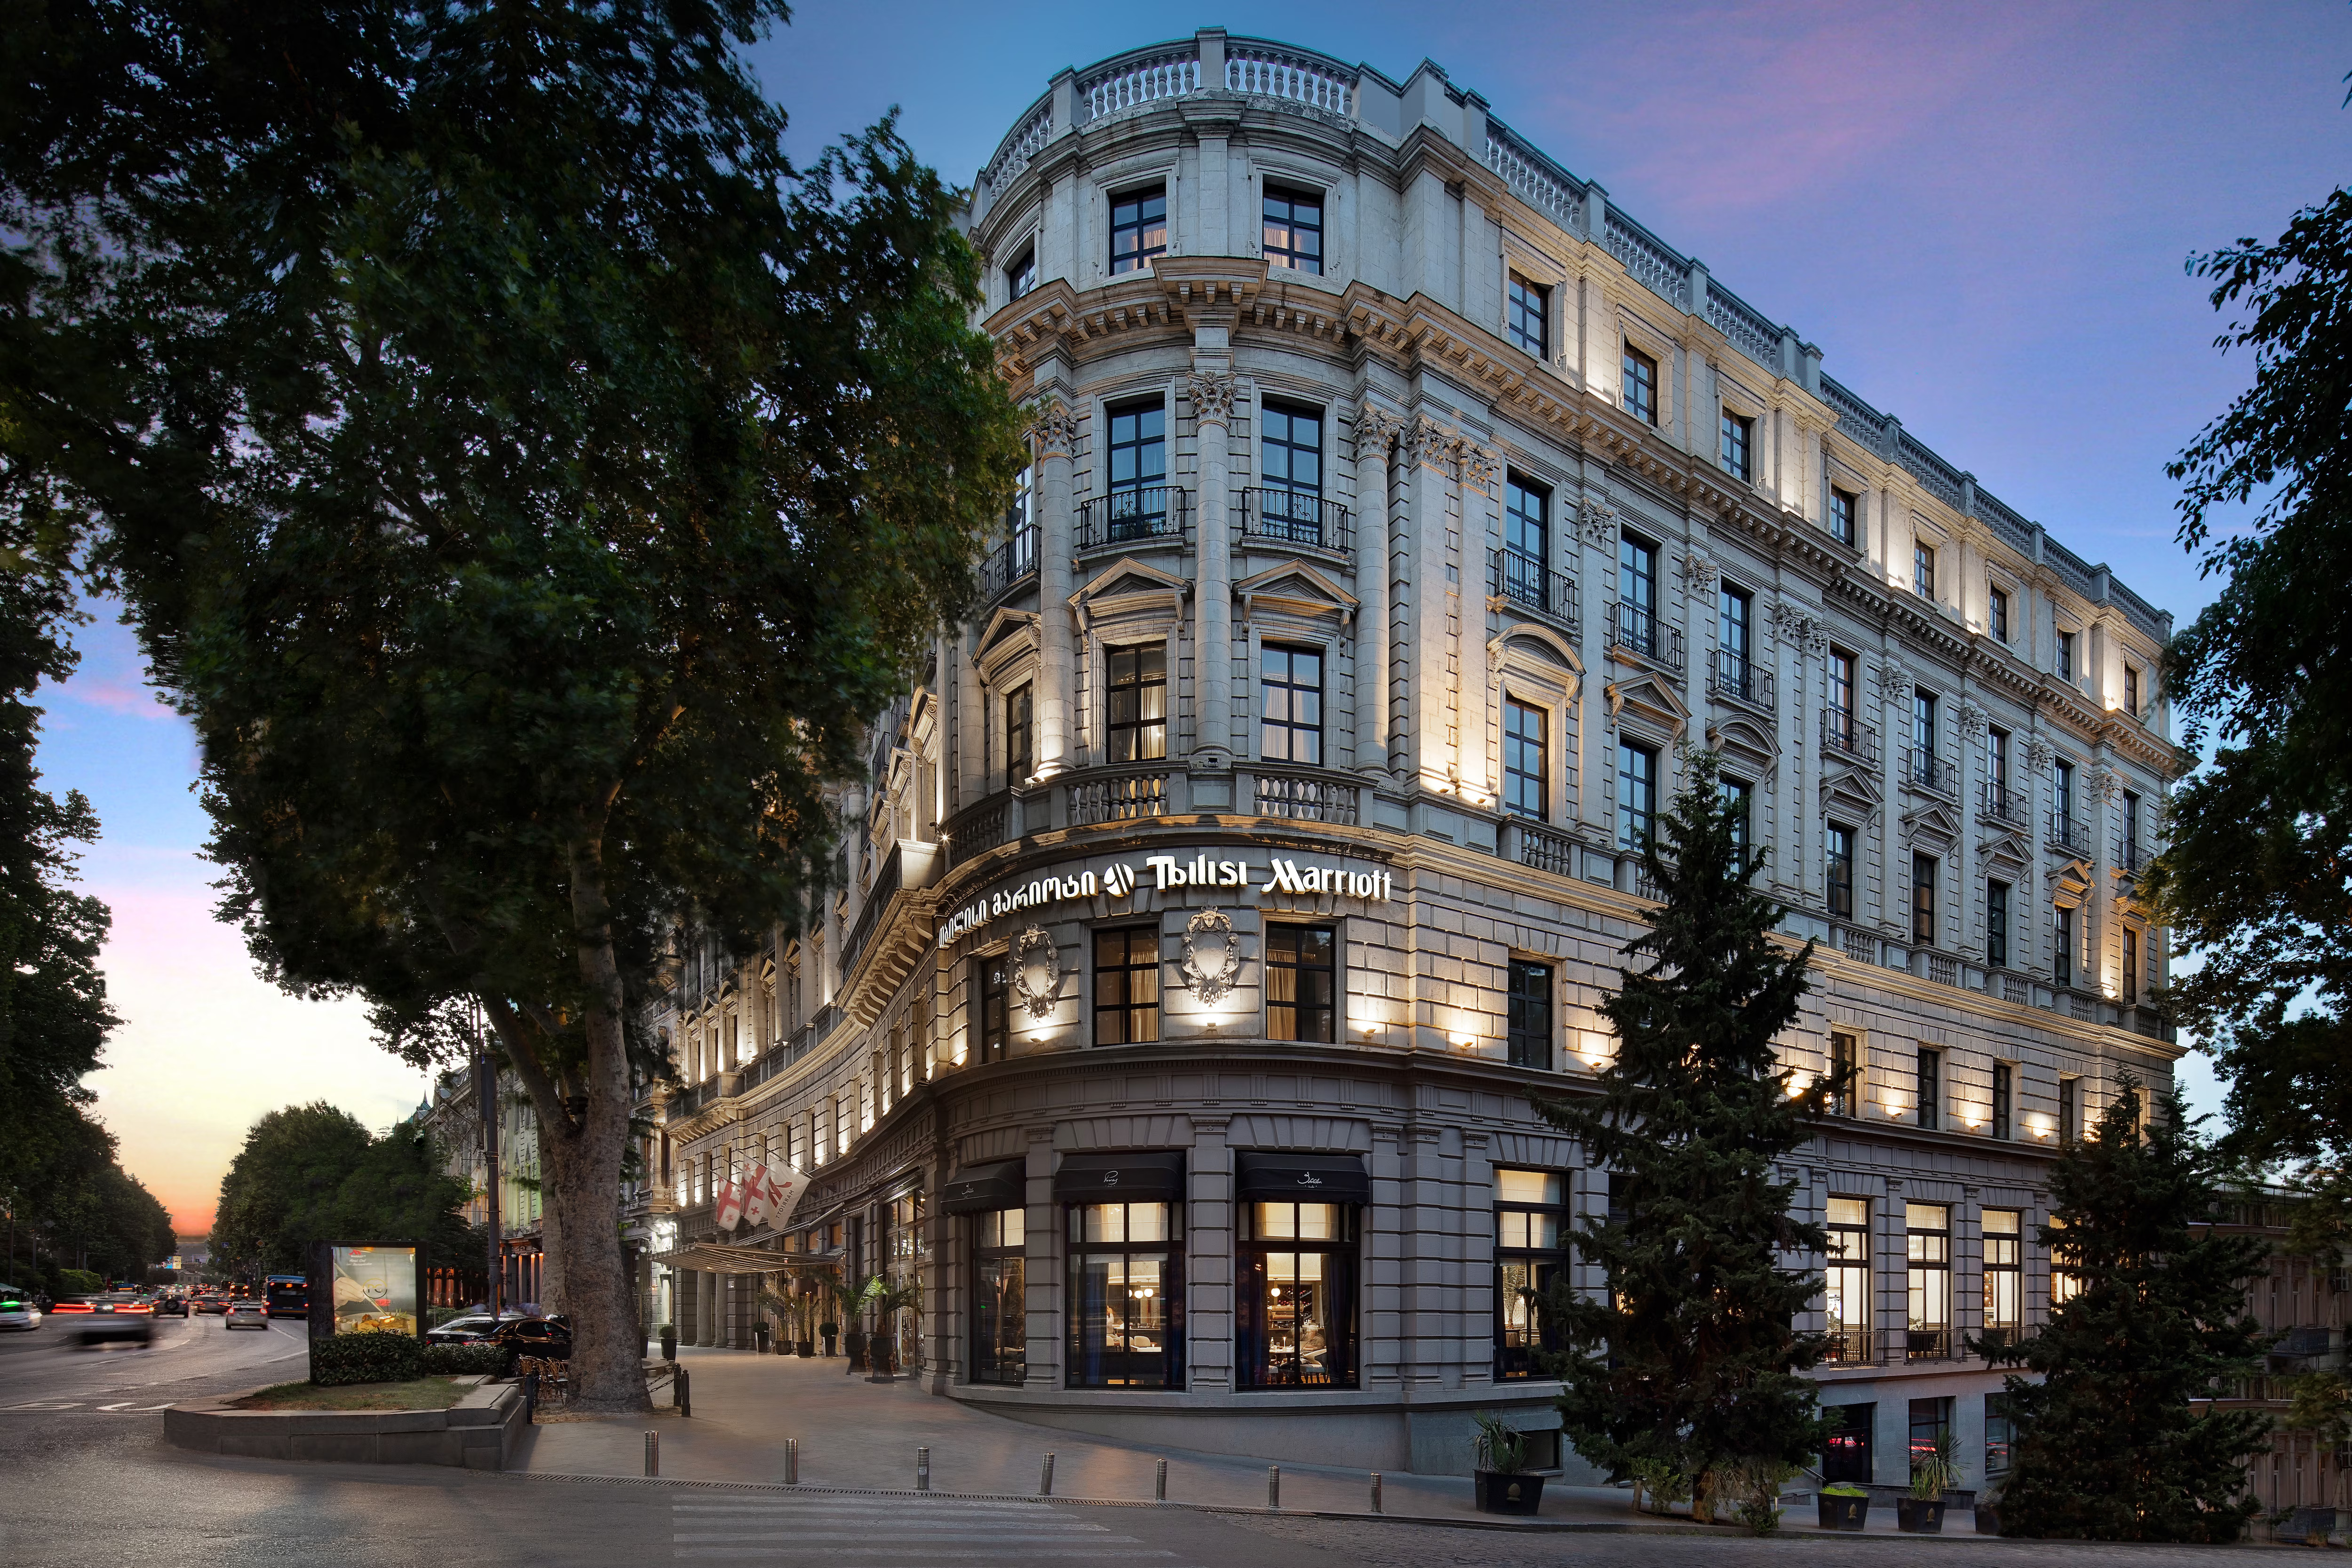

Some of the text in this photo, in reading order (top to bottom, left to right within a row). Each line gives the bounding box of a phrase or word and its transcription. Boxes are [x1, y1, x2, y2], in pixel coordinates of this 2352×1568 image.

[939, 870, 1097, 949] თბილისი მარიოტი
[1146, 853, 1393, 902] Tbilisi Marriott
